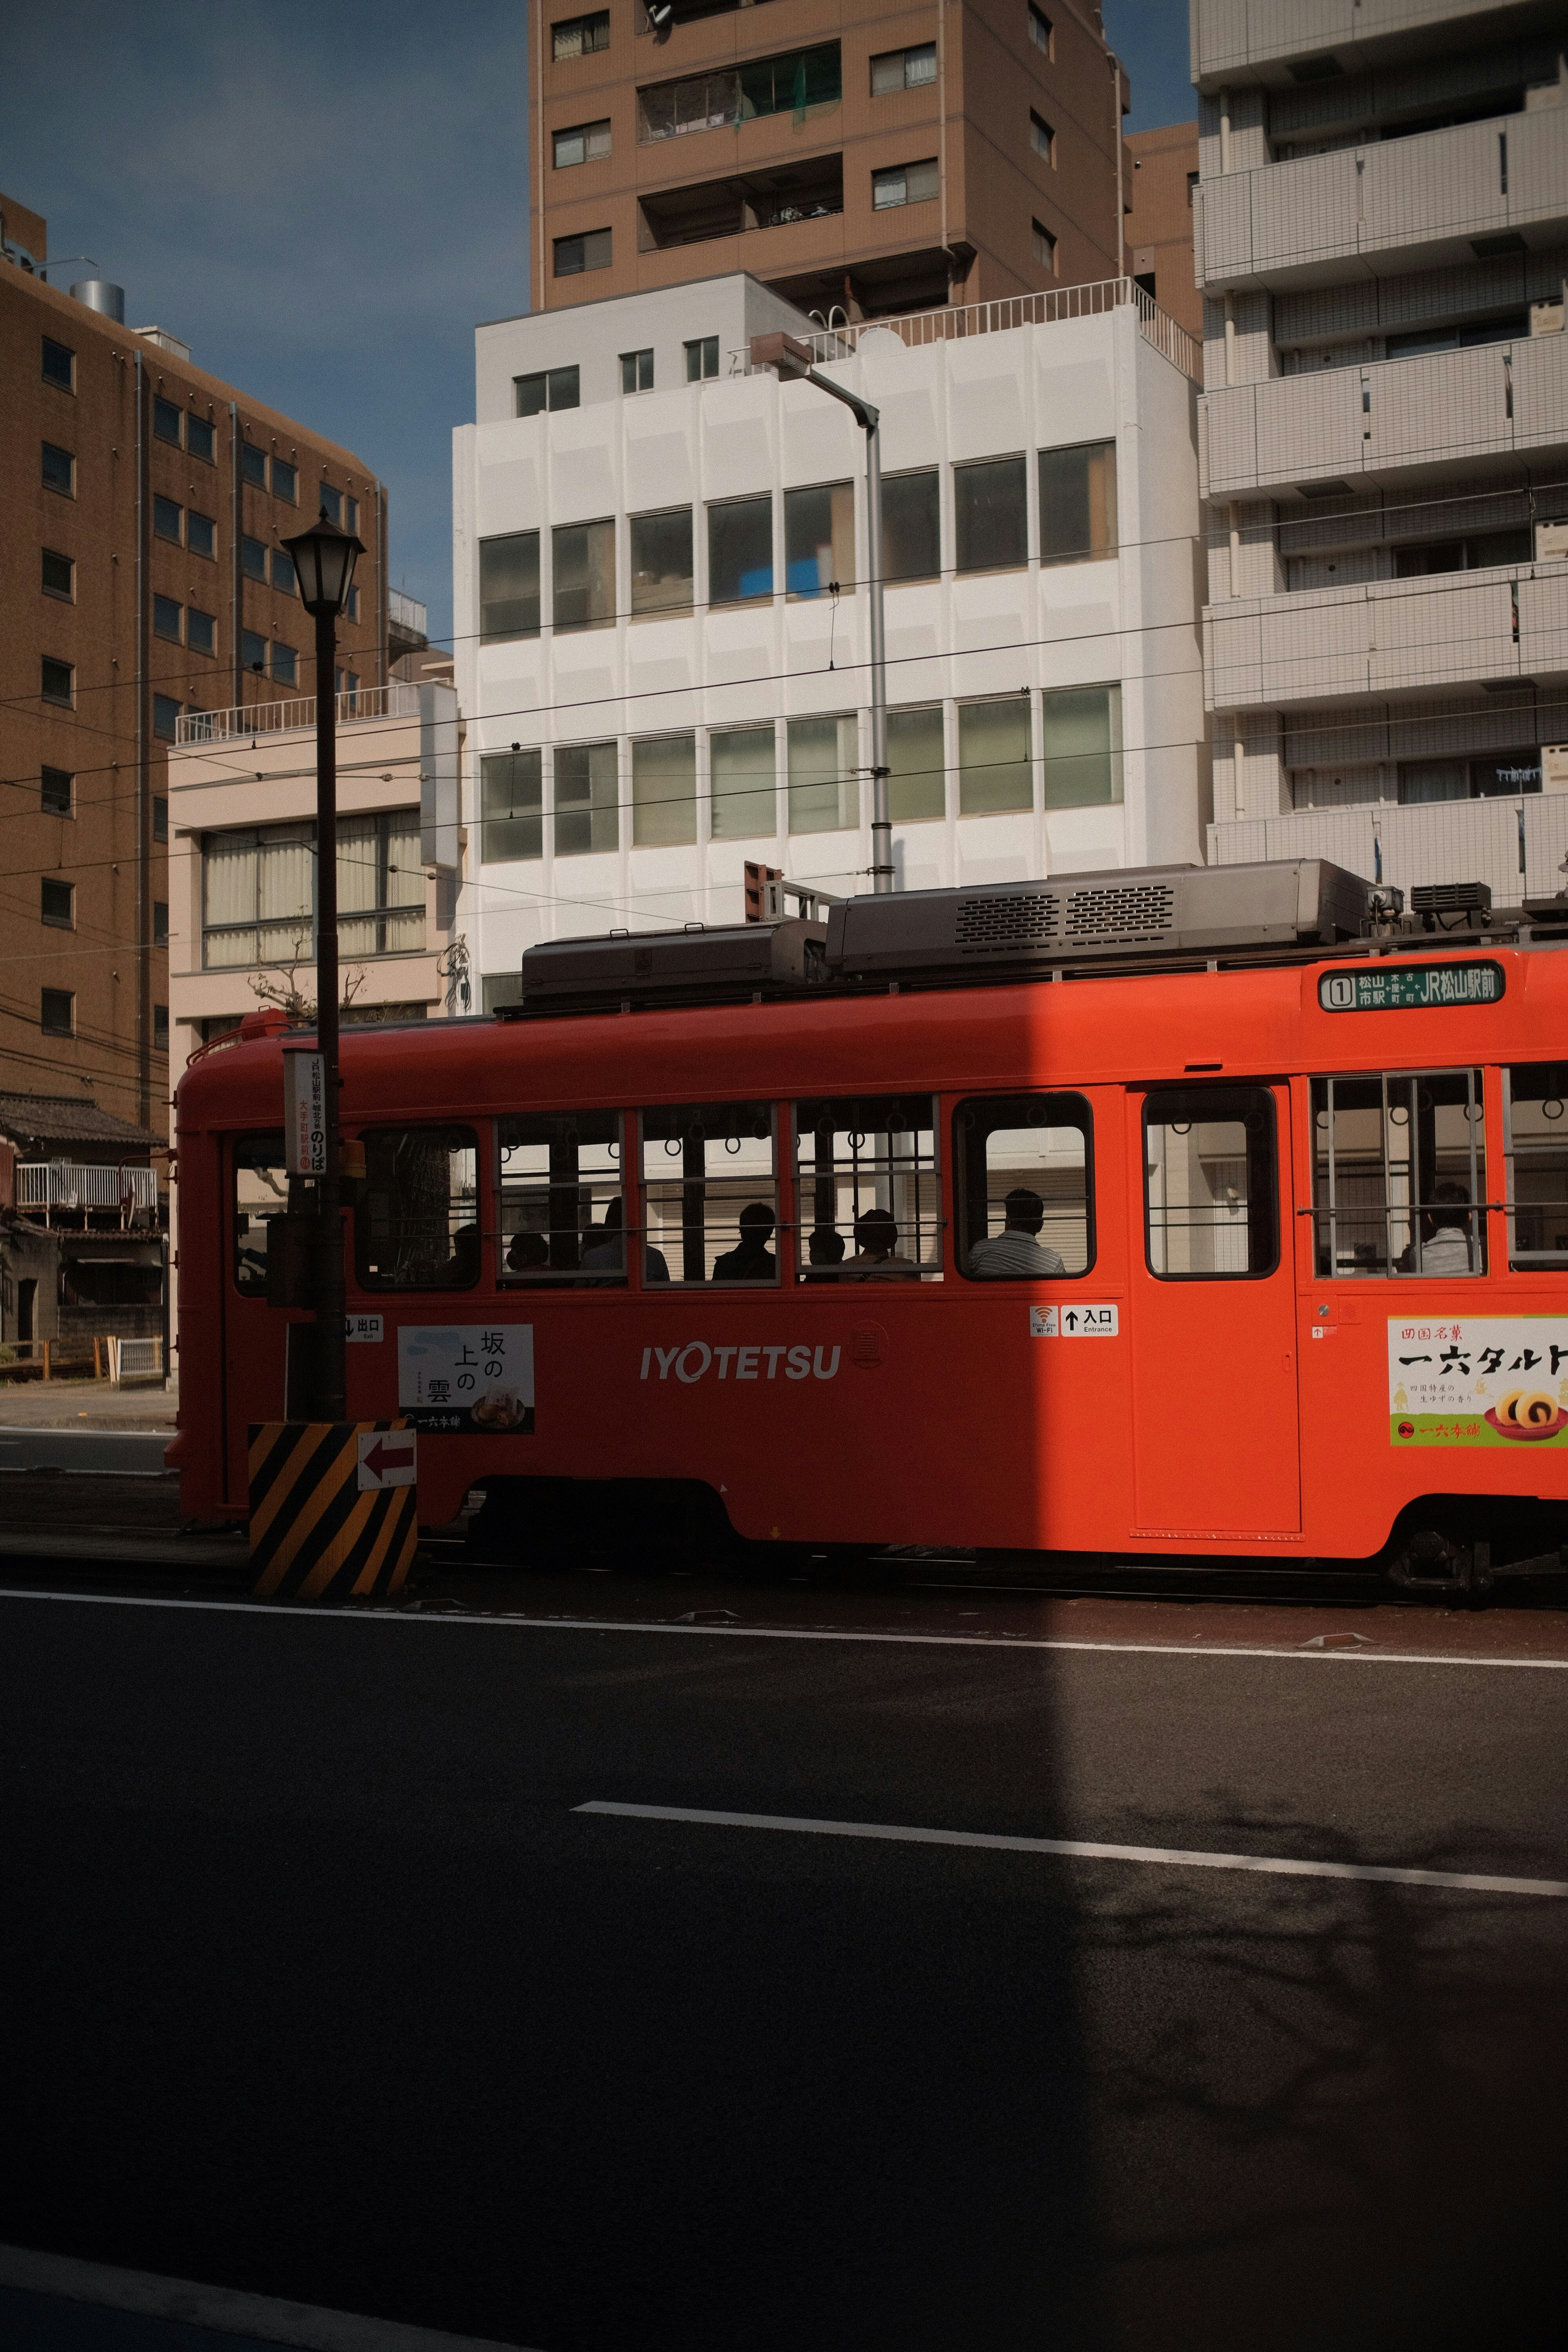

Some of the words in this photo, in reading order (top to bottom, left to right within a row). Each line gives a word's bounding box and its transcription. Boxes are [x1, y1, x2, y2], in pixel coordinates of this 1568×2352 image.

[1336, 981, 1344, 1002] 1
[1359, 975, 1384, 990] 松山
[1391, 974, 1400, 1003] 木屋町
[1406, 973, 1414, 1002] 古町
[1420, 968, 1495, 1002] JR松山駅前
[1359, 990, 1385, 1005] 市駅
[300, 1099, 308, 1155] 大手町駅前
[358, 1319, 378, 1332] 出口
[1084, 1310, 1111, 1324] 入口
[1402, 1325, 1463, 1341] 四国名菓
[455, 1345, 479, 1390] 上の
[481, 1331, 506, 1378] 坂の
[640, 1340, 841, 1383] IYOTETSU
[1398, 1344, 1568, 1376] 一六タルト
[428, 1379, 451, 1403] 雲
[1410, 1384, 1455, 1392] 四国特産の
